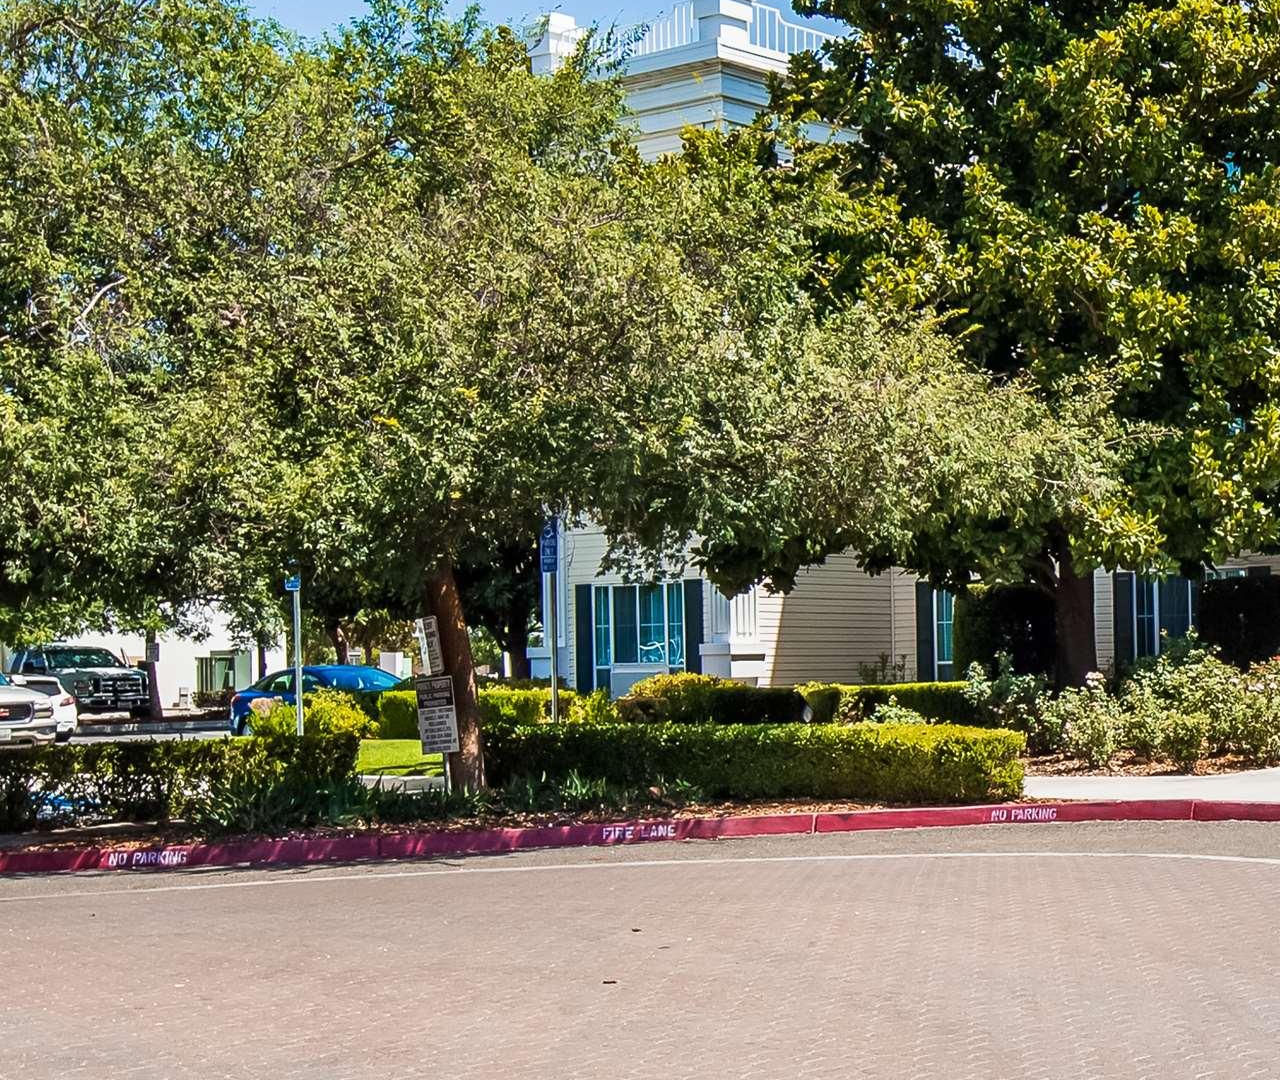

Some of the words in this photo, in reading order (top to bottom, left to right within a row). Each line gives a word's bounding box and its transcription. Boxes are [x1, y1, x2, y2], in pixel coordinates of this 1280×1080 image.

[991, 809, 1007, 821] NO
[1011, 807, 1057, 821] PARKING
[602, 826, 634, 840] FIRE
[641, 824, 676, 837] LANE
[108, 852, 128, 866] NO
[132, 851, 187, 865] PARKING
